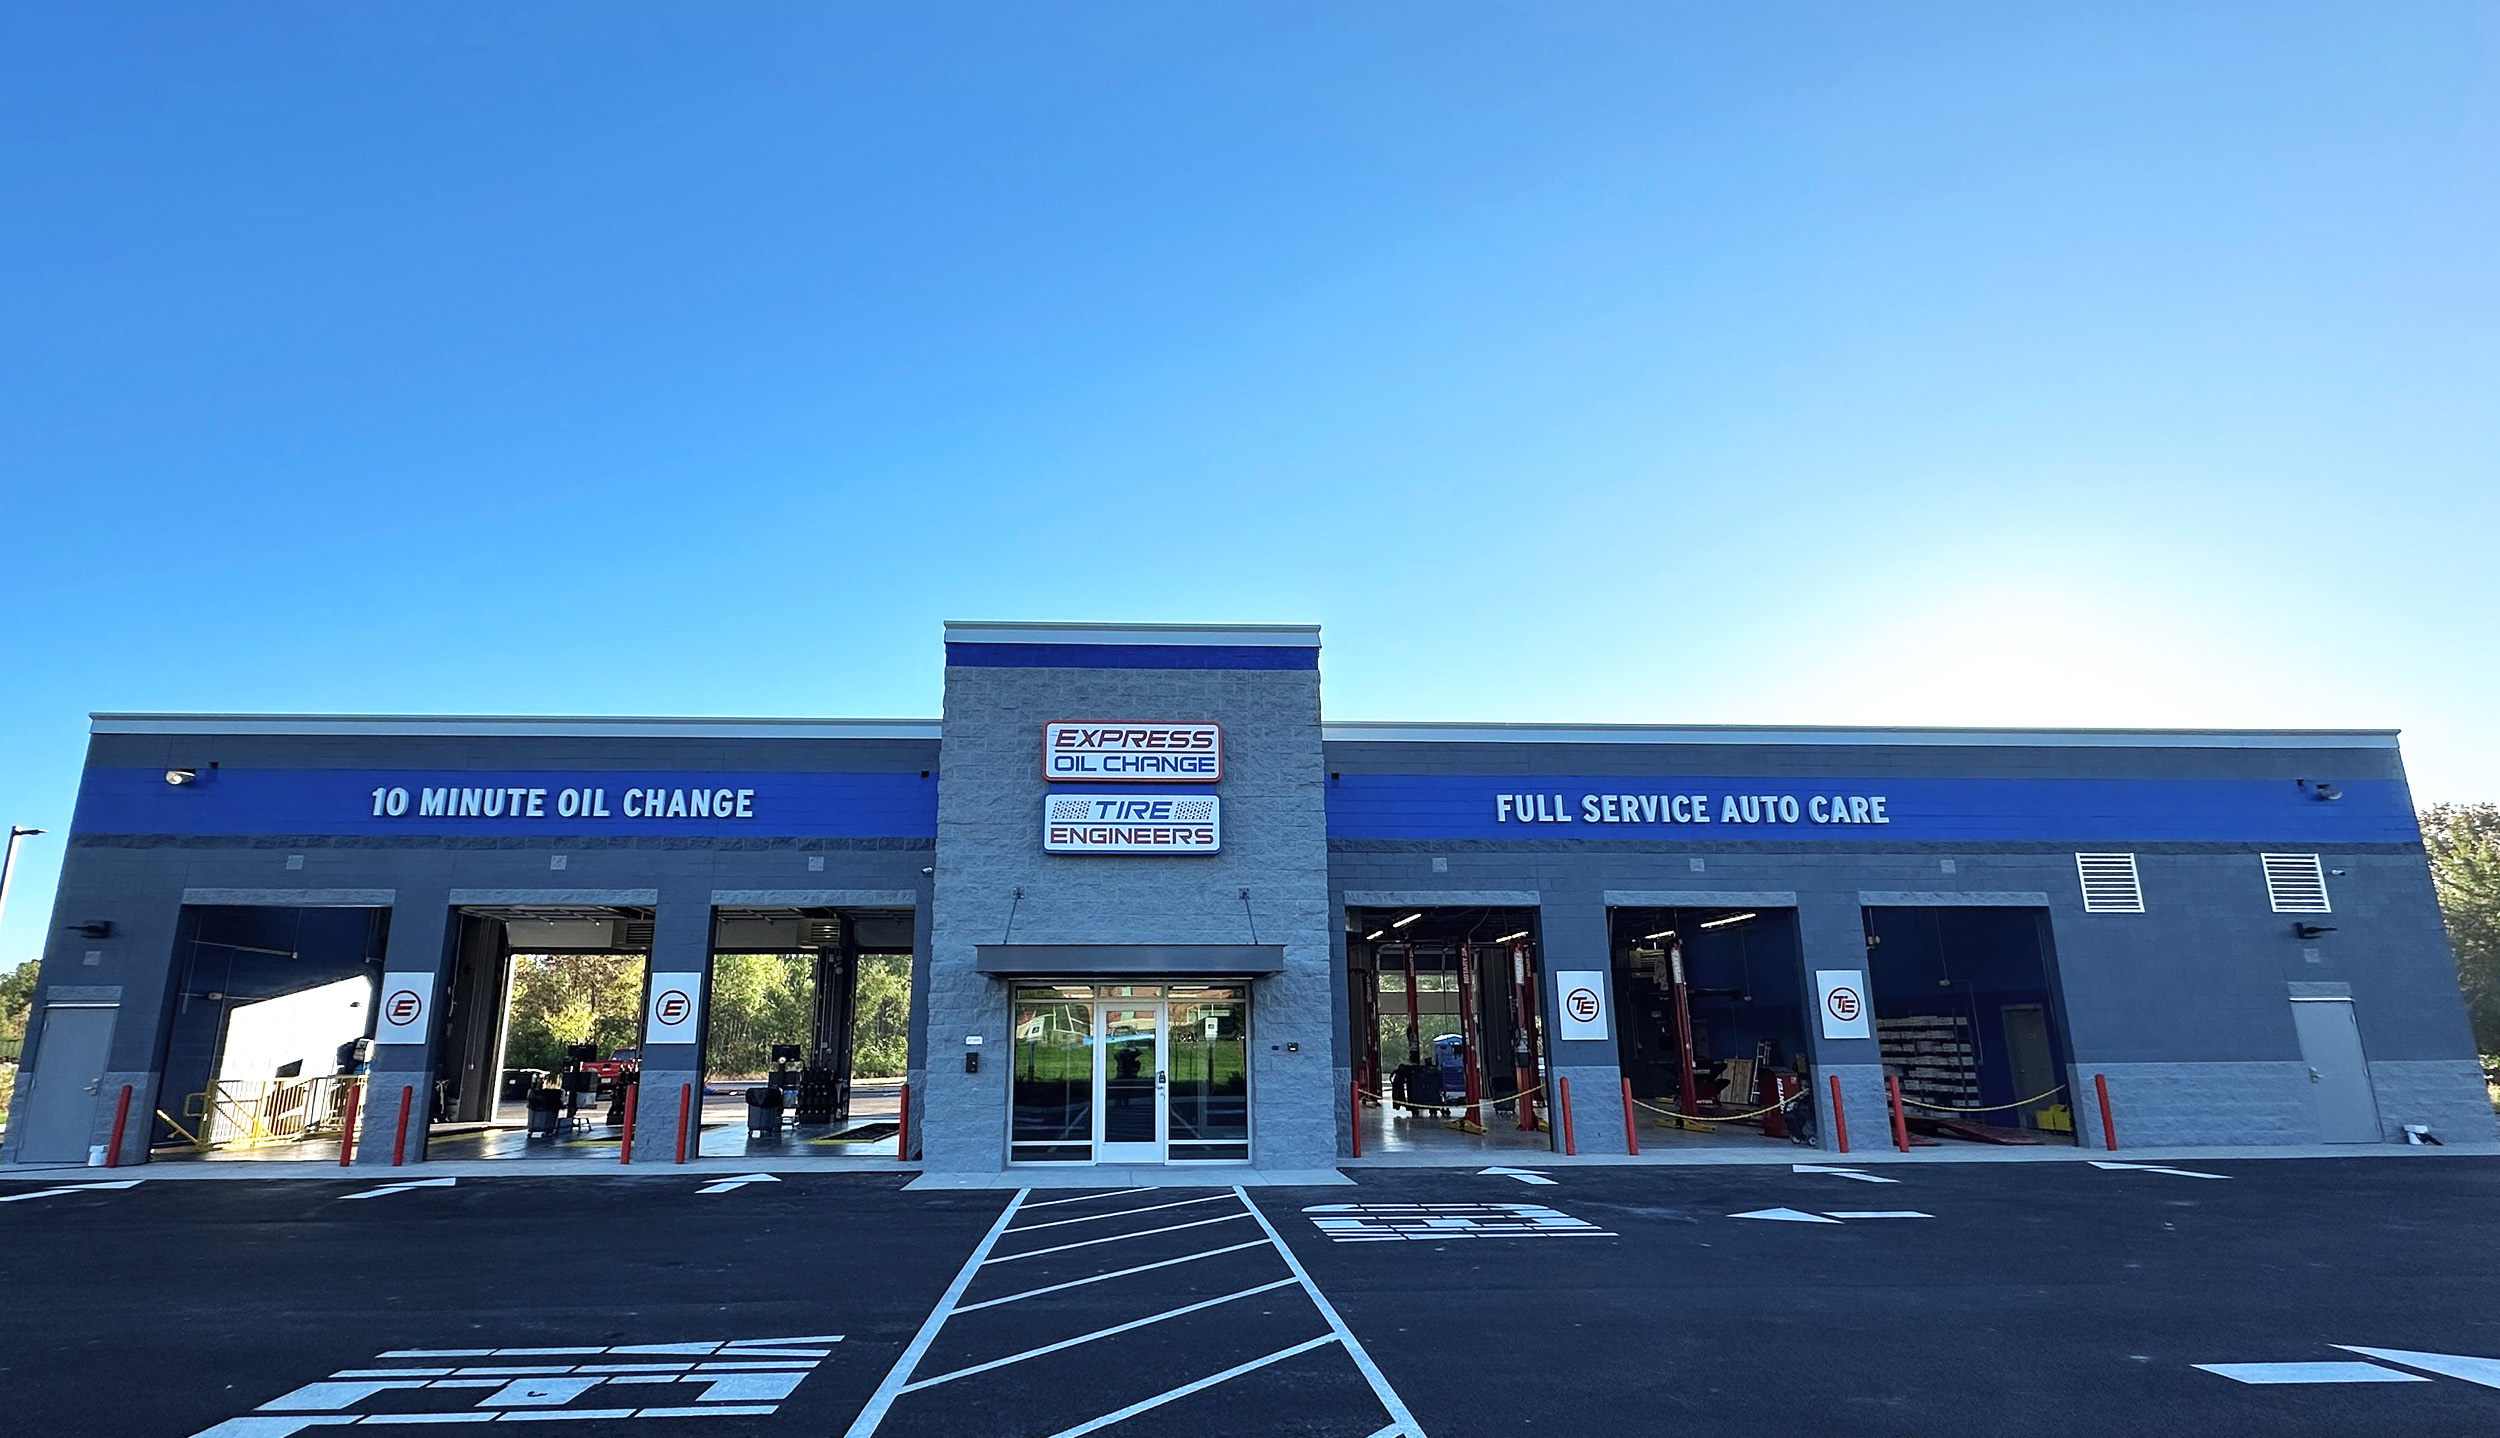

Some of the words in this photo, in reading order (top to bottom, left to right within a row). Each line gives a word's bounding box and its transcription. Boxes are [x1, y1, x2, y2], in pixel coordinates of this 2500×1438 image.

[1055, 729, 1214, 749] EXPRESS
[1054, 755, 1097, 772] OIL
[1103, 755, 1215, 773] CHANGE
[371, 787, 409, 817] 10
[419, 787, 547, 817] MINUTE
[557, 787, 611, 818] OIL
[622, 788, 754, 818] CHANGE
[1096, 801, 1173, 820] TIRE
[1497, 794, 1572, 823] FULL
[1581, 794, 1710, 823] SERVICE
[1720, 795, 1800, 824] AUTO
[1808, 795, 1890, 824] CARE
[1050, 827, 1214, 845] ENGINEERS
[1461, 956, 1470, 984] ROTARY
[188, 1335, 846, 1438] YIEL
